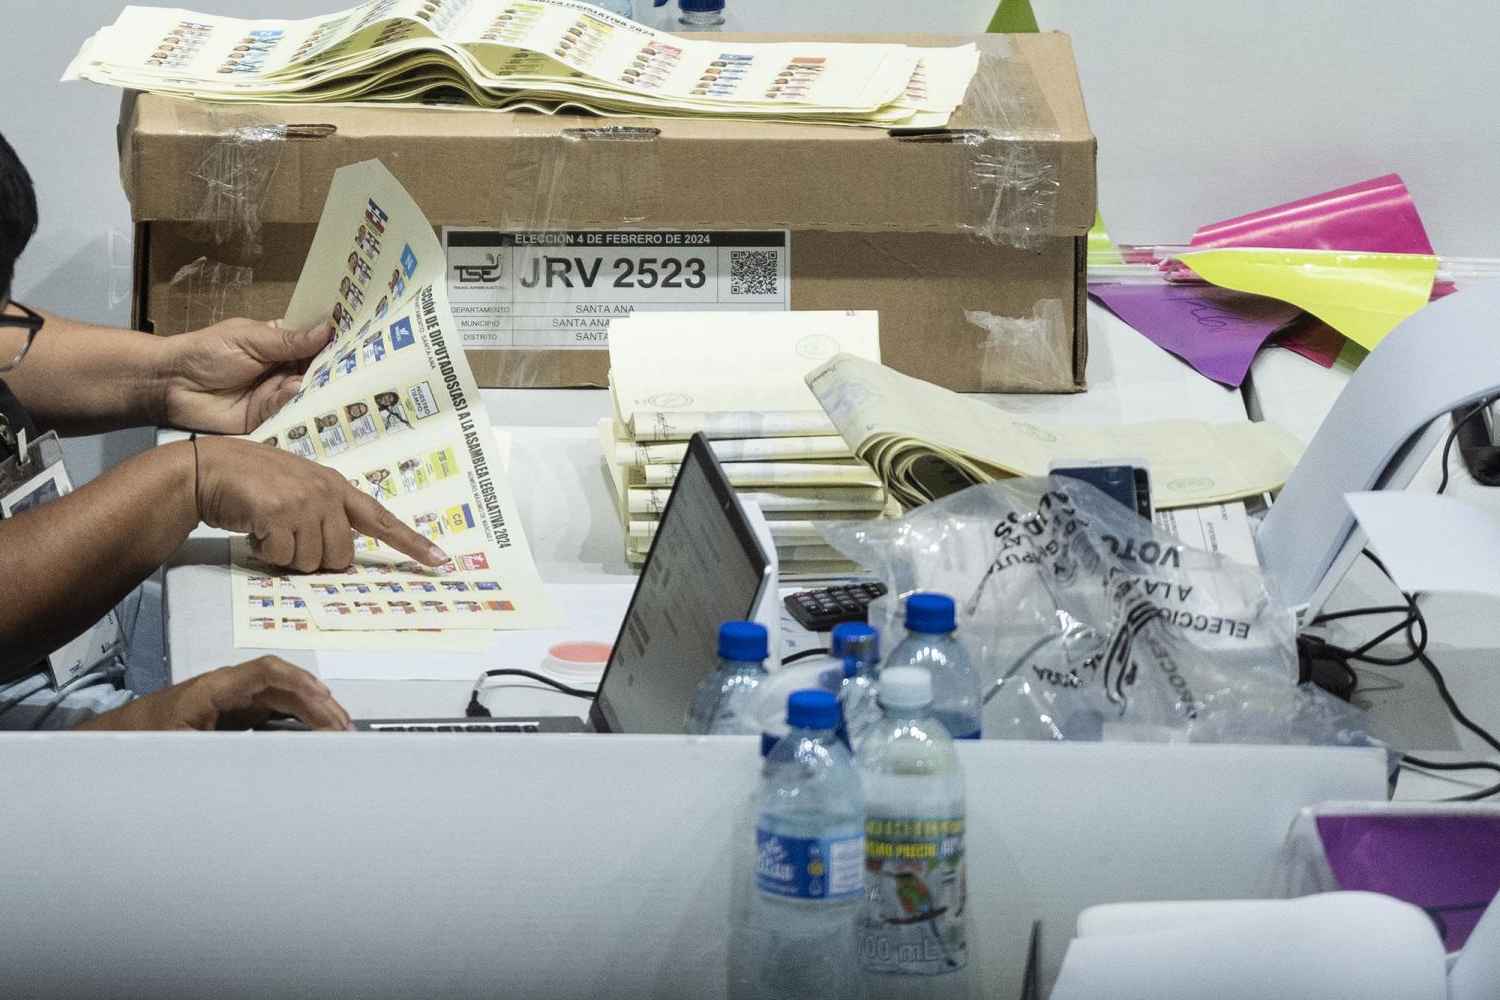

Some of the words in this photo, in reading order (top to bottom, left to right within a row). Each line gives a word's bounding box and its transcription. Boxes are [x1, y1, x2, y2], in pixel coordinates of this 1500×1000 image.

[515, 232, 574, 244] ELECCIÓN
[577, 234, 583, 244] 4
[587, 234, 602, 244] DE
[606, 234, 661, 244] FEBRERO
[665, 234, 681, 244] DE
[685, 234, 710, 244] 2024
[519, 256, 603, 288] JRV
[613, 257, 706, 288] 2523
[576, 305, 610, 313] SANTA
[614, 305, 634, 313] ANA
[425, 315, 439, 330] DE
[552, 319, 586, 327] SANTA
[590, 319, 610, 327] ANA
[411, 388, 423, 412] TIEMPO
[416, 386, 430, 415] NUESTRO
[457, 412, 470, 420] A
[461, 420, 475, 432] LA
[464, 431, 489, 479] ASAMBLEA
[479, 477, 505, 529] LEGISLATIVA
[452, 513, 462, 526] CD
[494, 528, 512, 549] 2024
